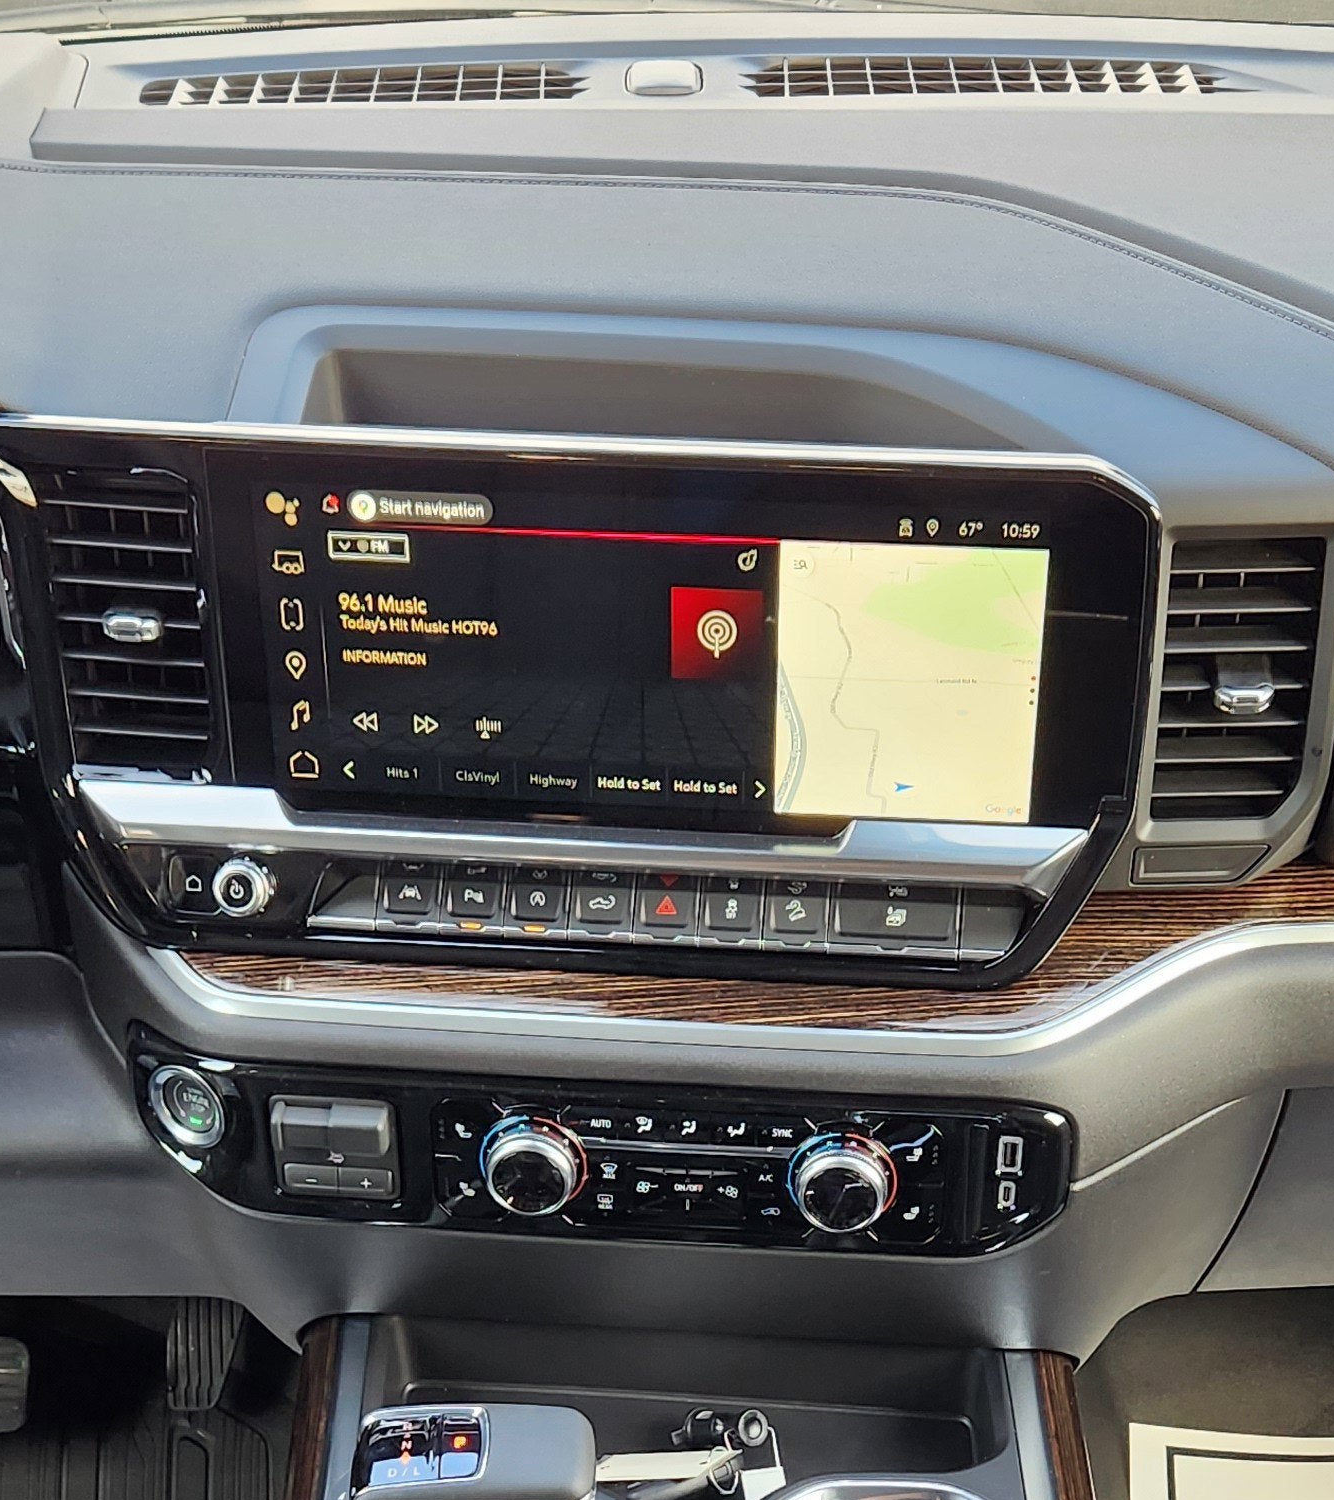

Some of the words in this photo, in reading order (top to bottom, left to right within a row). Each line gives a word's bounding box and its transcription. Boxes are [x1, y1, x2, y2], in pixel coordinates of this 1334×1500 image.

[380, 498, 412, 515] Start
[416, 500, 485, 519] navigation
[1002, 523, 1040, 538] 10:59
[370, 540, 389, 553] FM
[338, 592, 373, 612] 96.1
[378, 593, 427, 615] Music
[340, 615, 387, 634] Today's
[389, 618, 408, 632] Hit
[411, 619, 449, 634] Music
[452, 620, 498, 637] HOT96
[343, 649, 426, 666] INFORMATION
[386, 767, 409, 779] Hits
[529, 774, 577, 789] Highway
[597, 776, 624, 789] Hold
[627, 778, 639, 790] to
[641, 778, 661, 791] Set
[673, 780, 700, 793] Hold
[703, 781, 716, 793] to
[718, 782, 737, 795] Set
[590, 1118, 612, 1129] AUTO
[771, 1128, 793, 1138] SYNC
[674, 1183, 704, 1192] ON/OFF
